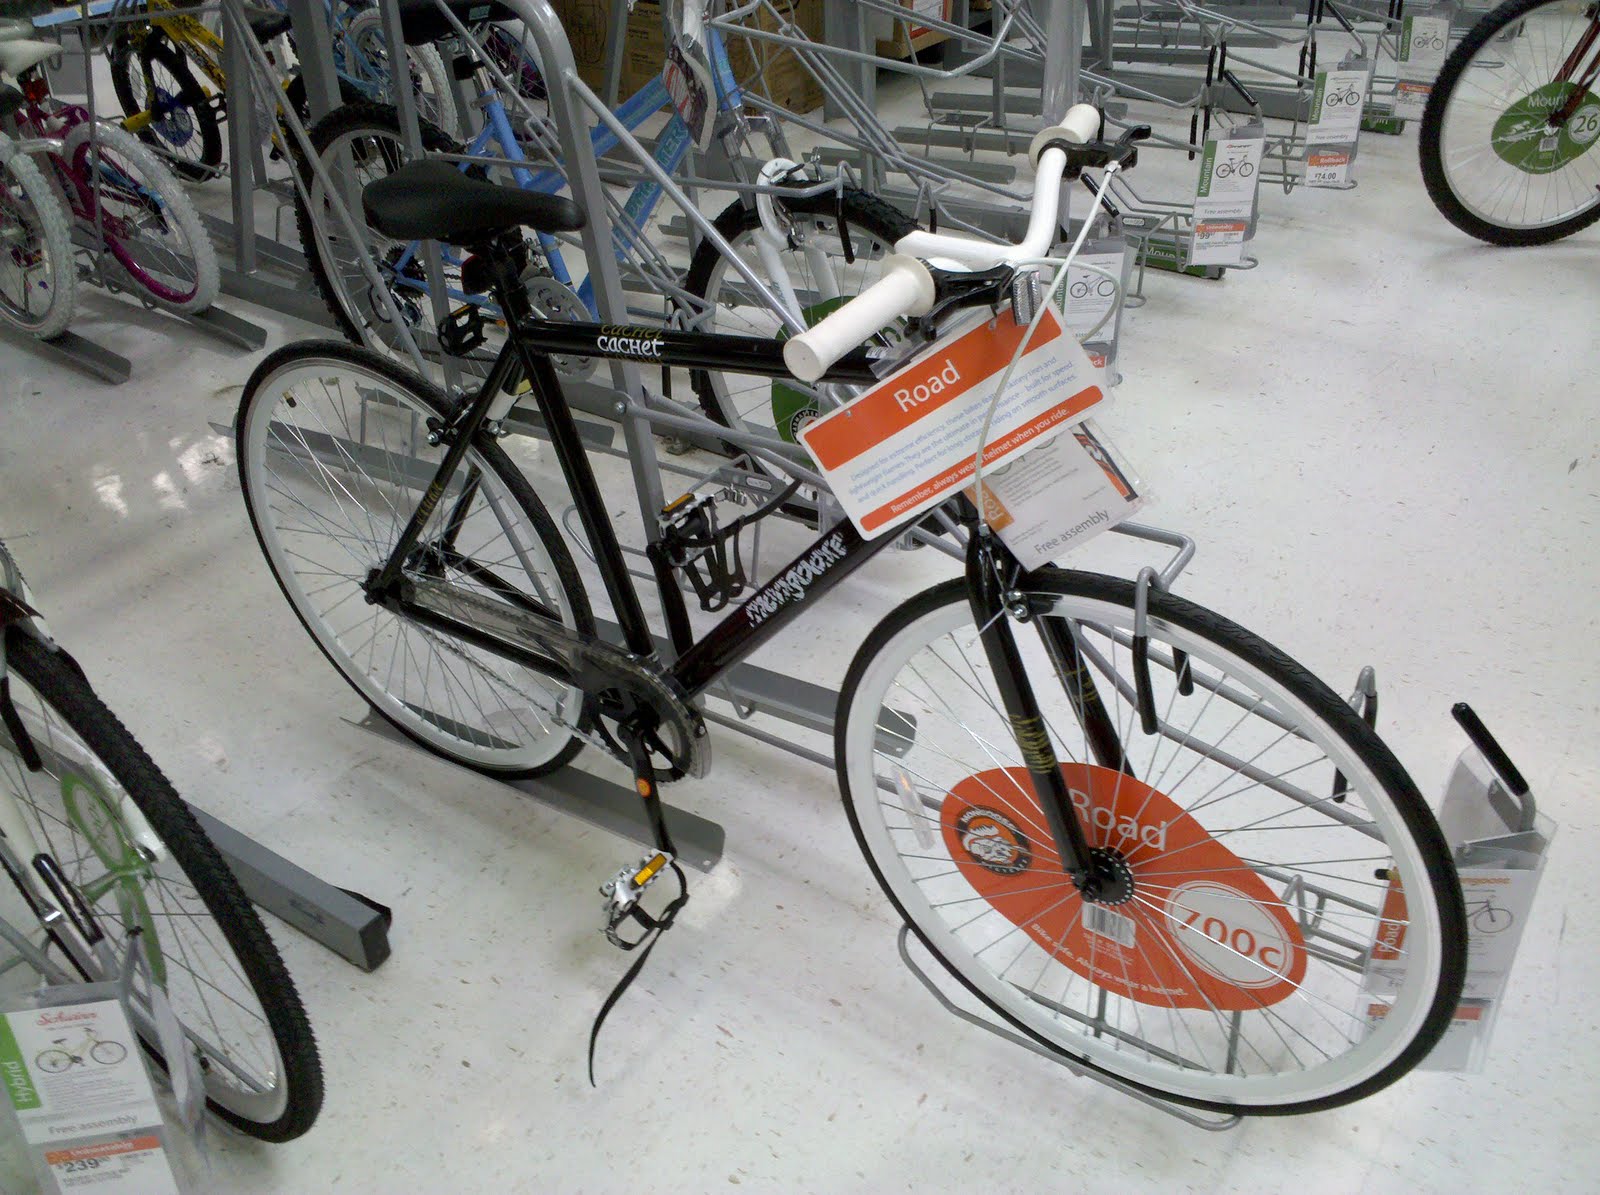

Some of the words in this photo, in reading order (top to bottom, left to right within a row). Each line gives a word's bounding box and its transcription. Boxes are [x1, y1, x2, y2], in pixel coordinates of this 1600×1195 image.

[1573, 113, 1598, 134] 26
[1200, 157, 1213, 194] Mountain
[893, 359, 961, 413] Road
[891, 486, 932, 512] Remember,
[933, 472, 958, 490] always
[984, 441, 1010, 459] helmet
[1012, 428, 1032, 443] when
[1035, 421, 1050, 432] you
[1051, 408, 1068, 421] ride.
[1033, 538, 1061, 555] Free
[1061, 509, 1111, 542] assembly
[1069, 788, 1168, 851] Road
[1179, 911, 1281, 970] 700c
[4, 1060, 33, 1103] Hybrid
[48, 1125, 76, 1135] Free
[79, 1114, 138, 1130] assembly
